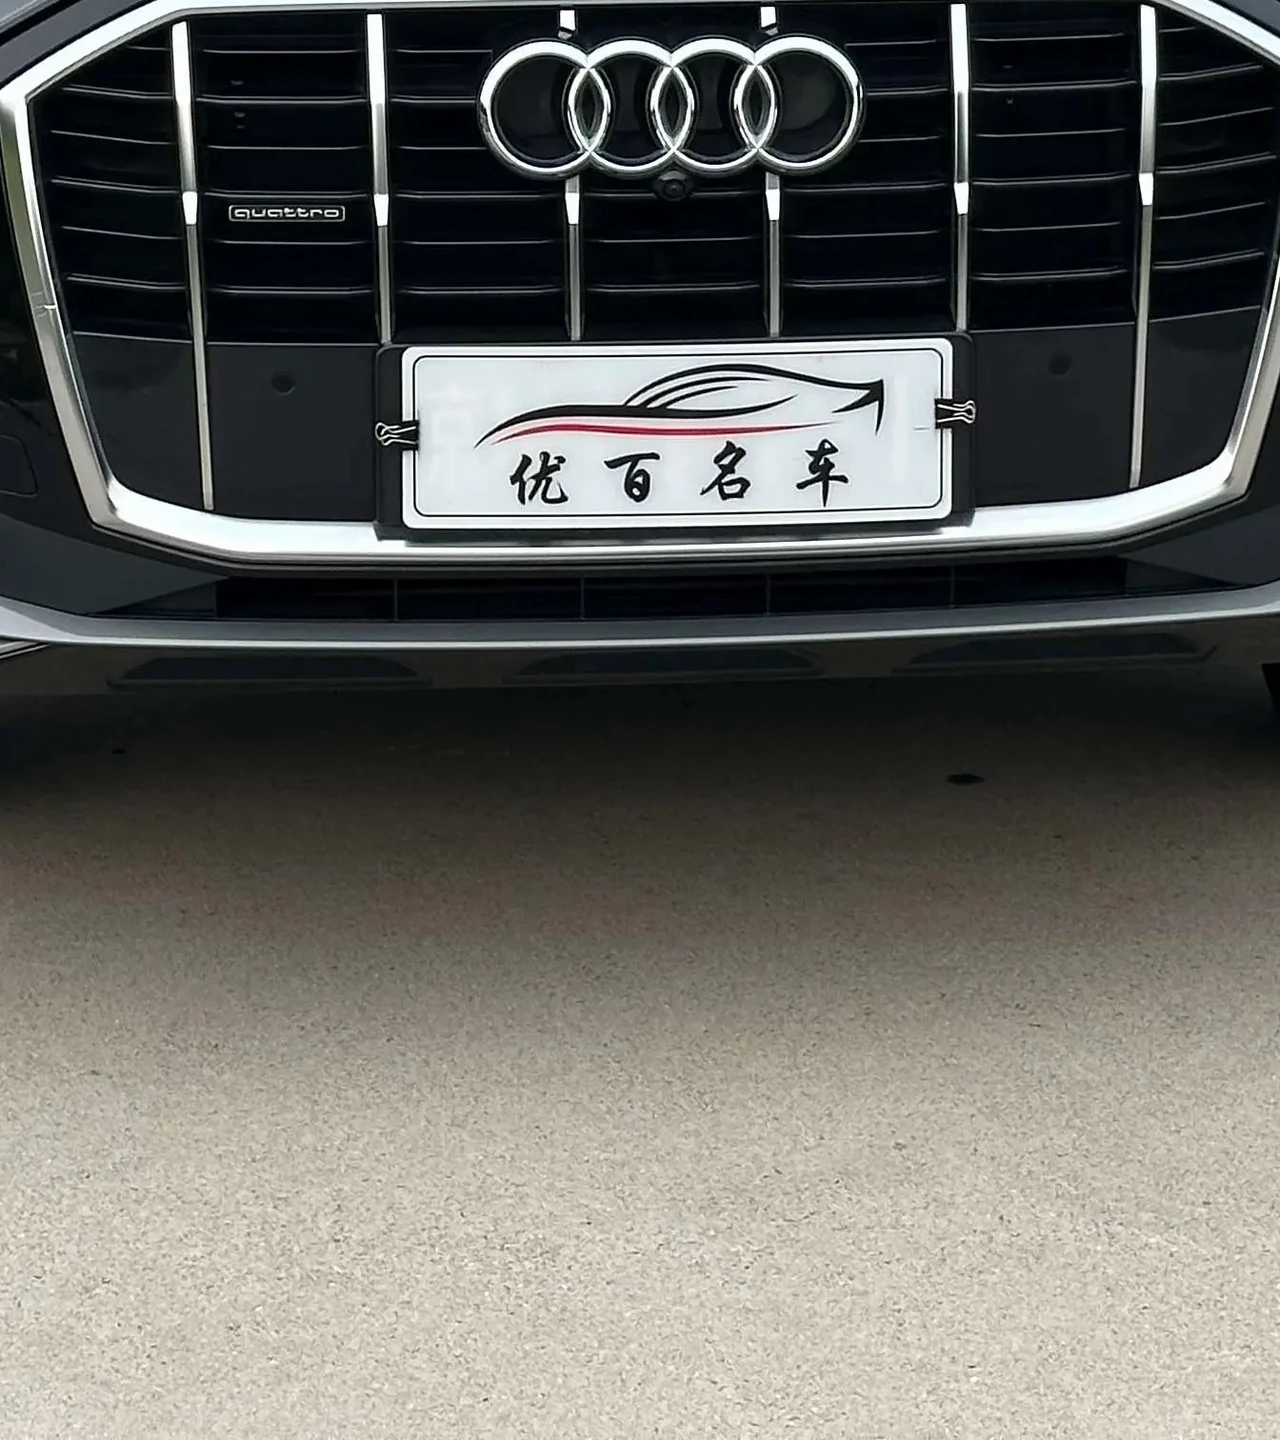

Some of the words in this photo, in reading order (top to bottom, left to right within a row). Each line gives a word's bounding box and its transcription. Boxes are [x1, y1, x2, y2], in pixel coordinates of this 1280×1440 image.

[234, 207, 340, 220] quattro
[509, 440, 850, 508] 优百名车
